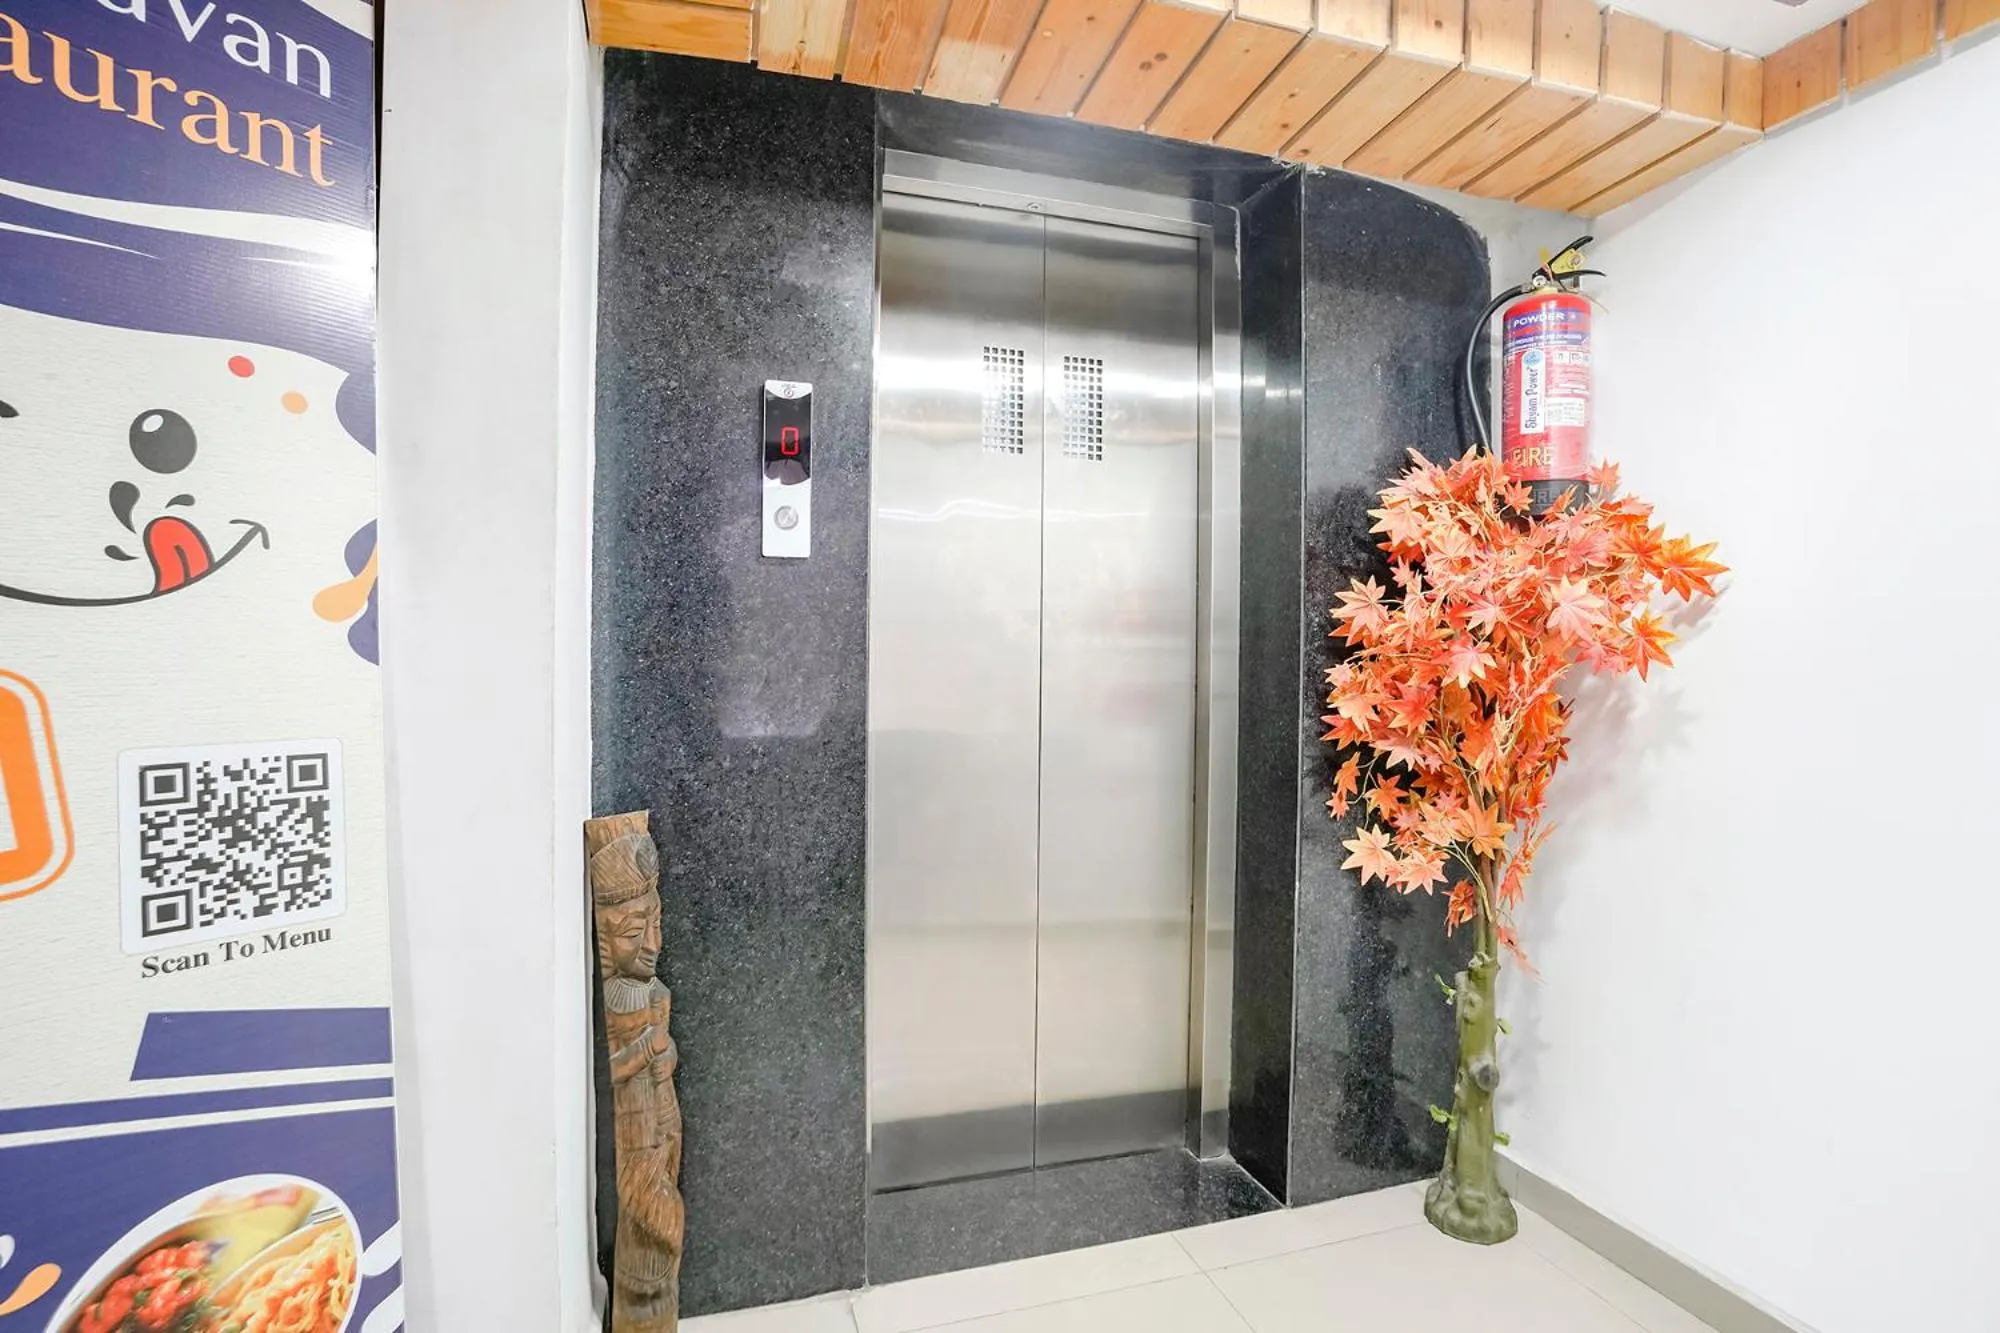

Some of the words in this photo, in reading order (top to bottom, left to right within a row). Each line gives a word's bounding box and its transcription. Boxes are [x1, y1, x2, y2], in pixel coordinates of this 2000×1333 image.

[1513, 311, 1566, 328] POWDER
[1525, 366, 1538, 396] Power
[781, 426, 800, 456] 0
[1512, 447, 1551, 468] FIRE
[141, 951, 210, 978] Scan
[219, 940, 255, 962] To
[262, 927, 332, 954] Menu
